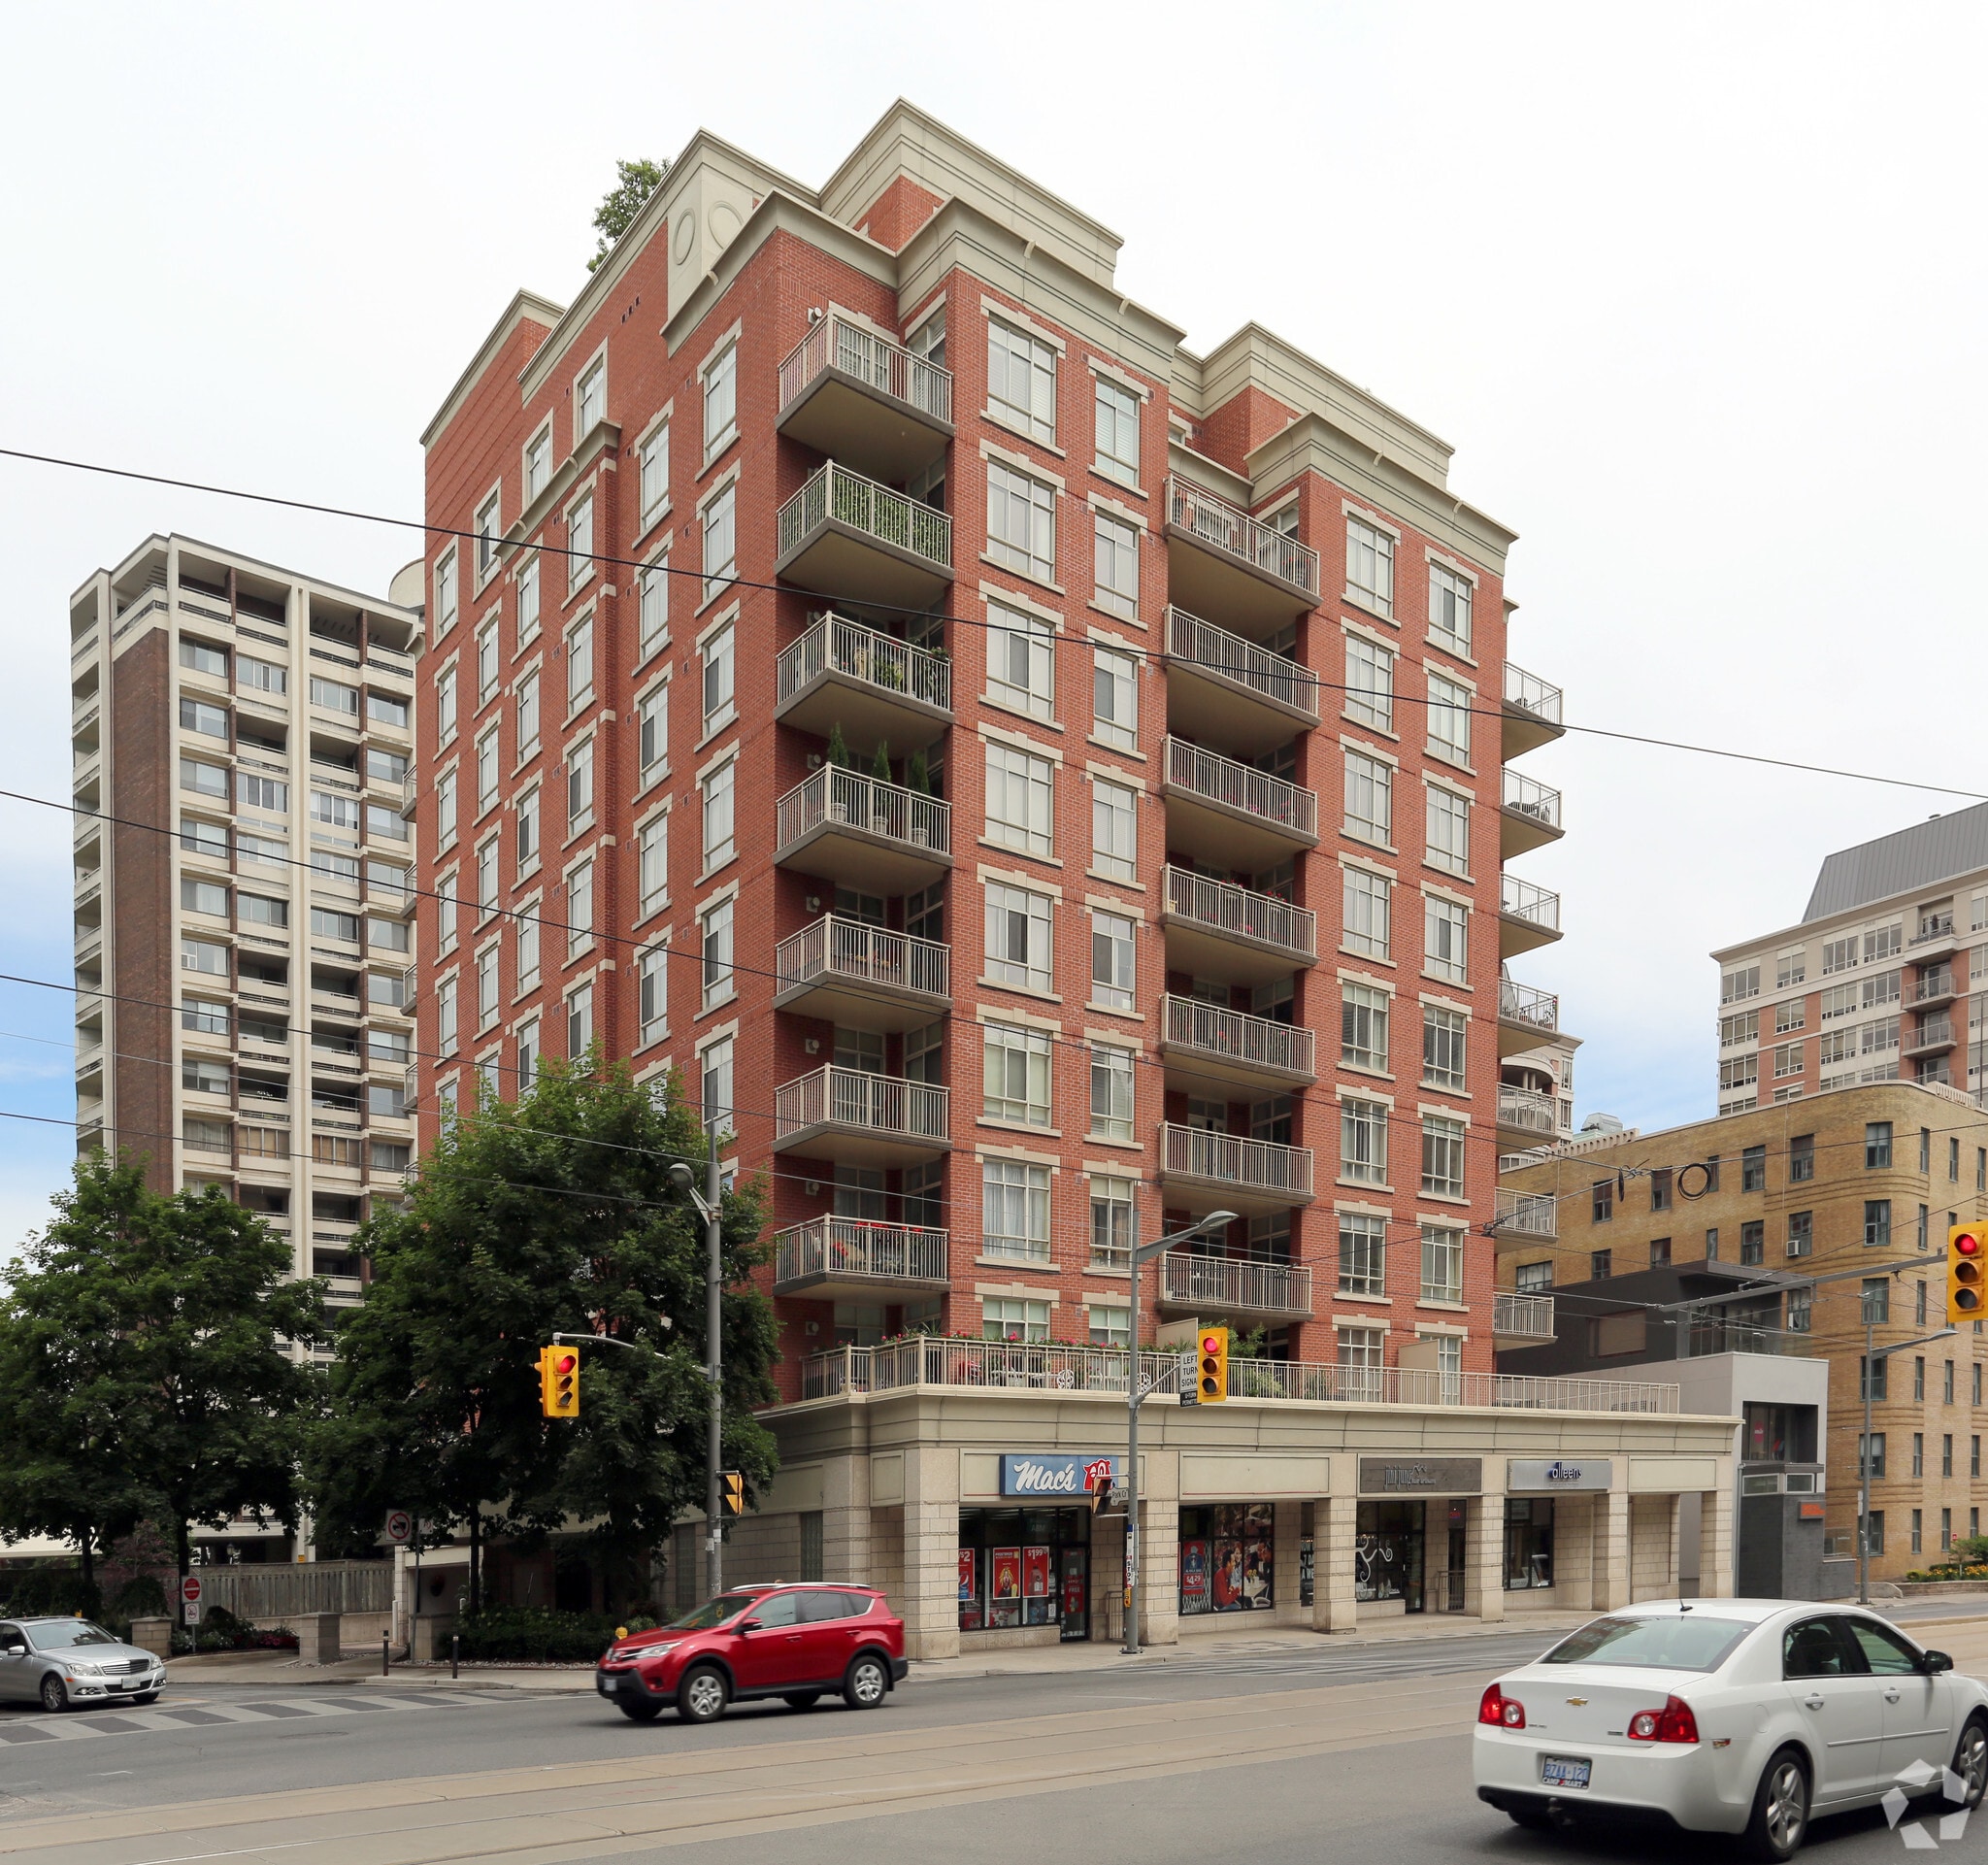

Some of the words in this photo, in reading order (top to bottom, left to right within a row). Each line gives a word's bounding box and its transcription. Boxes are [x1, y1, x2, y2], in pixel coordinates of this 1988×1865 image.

[1182, 1355, 1198, 1364] LEFT
[1182, 1367, 1199, 1376] TURN
[1181, 1378, 1198, 1386] SIGNA
[1013, 1460, 1077, 1492] Mac's
